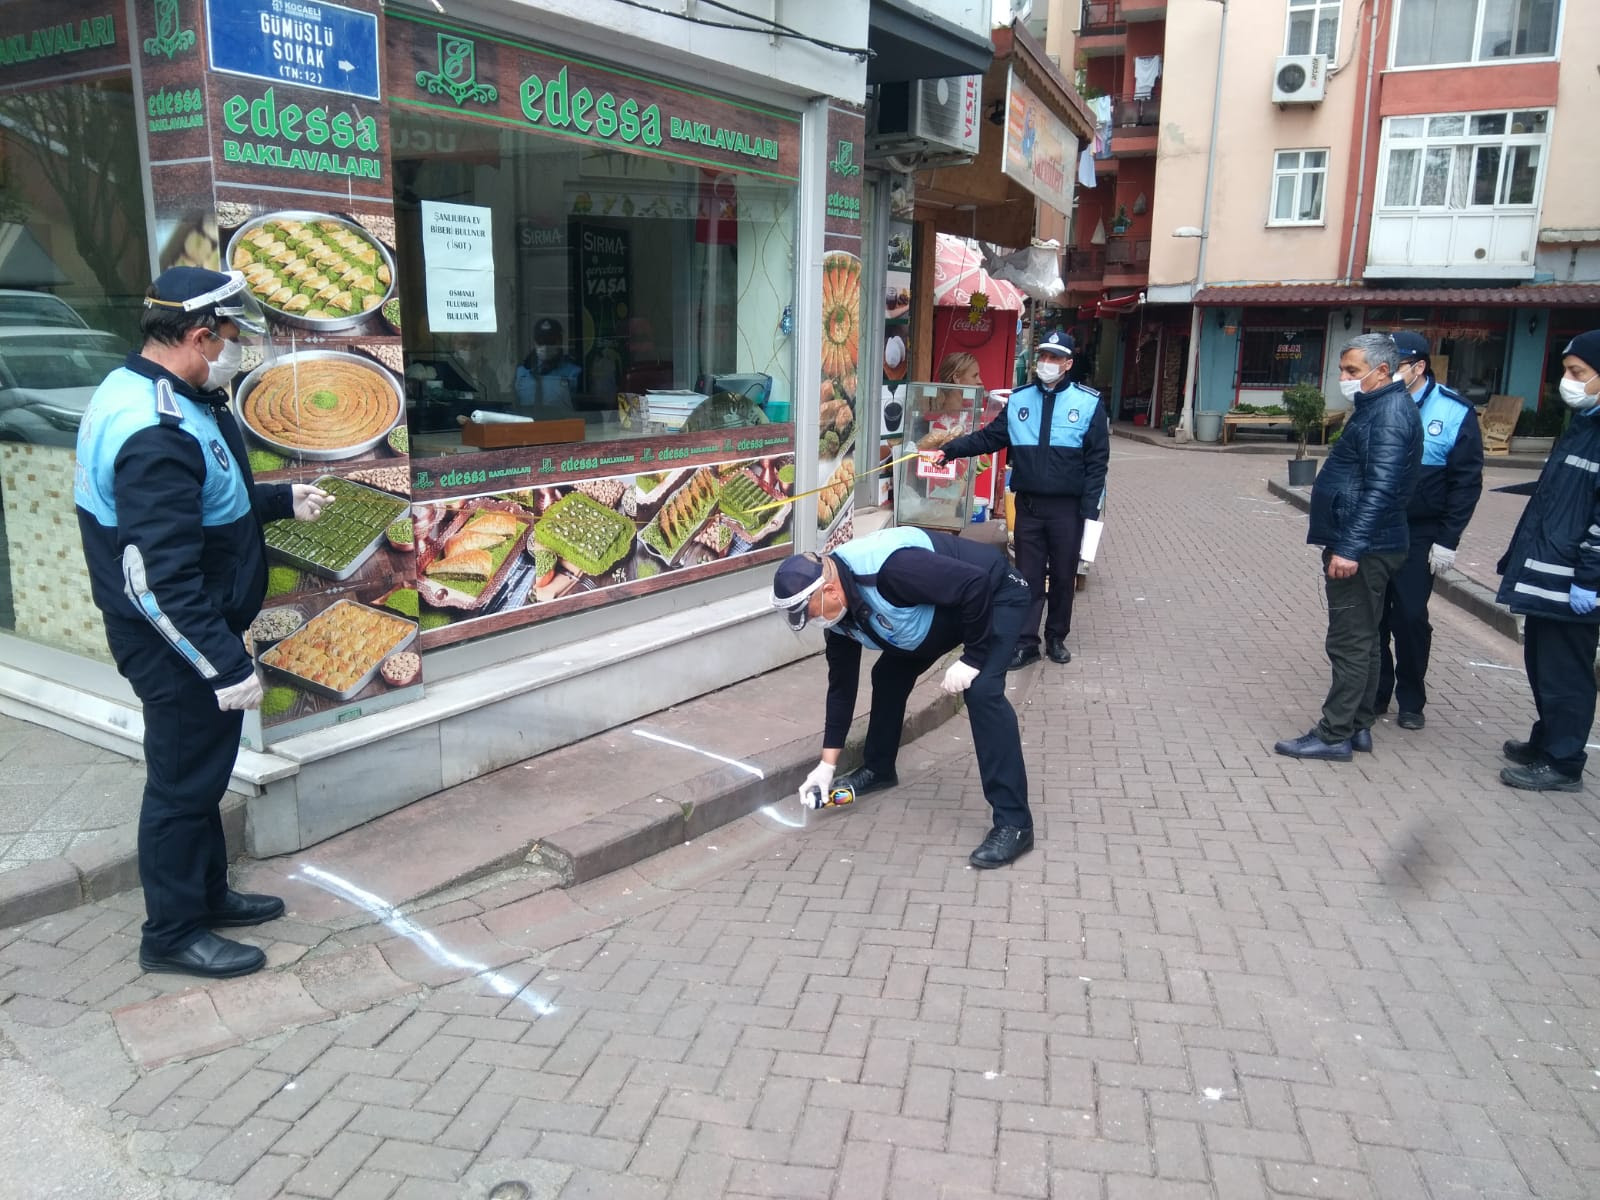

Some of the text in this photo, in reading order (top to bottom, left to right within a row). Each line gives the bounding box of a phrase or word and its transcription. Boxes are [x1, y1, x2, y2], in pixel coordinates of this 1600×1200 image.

[273, 40, 325, 69] SOKAK
[280, 65, 322, 84] (TN:12)
[148, 86, 202, 117] edessa
[223, 86, 379, 152] edessa
[519, 65, 778, 160] edessa BAKLAVALARI
[223, 140, 381, 178] BAKLAVALARI
[455, 228, 486, 238] BULUNUR
[446, 312, 479, 321] BULUNUR
[658, 447, 689, 461] edessa
[561, 456, 598, 473] edessa
[440, 468, 486, 487] edessa
